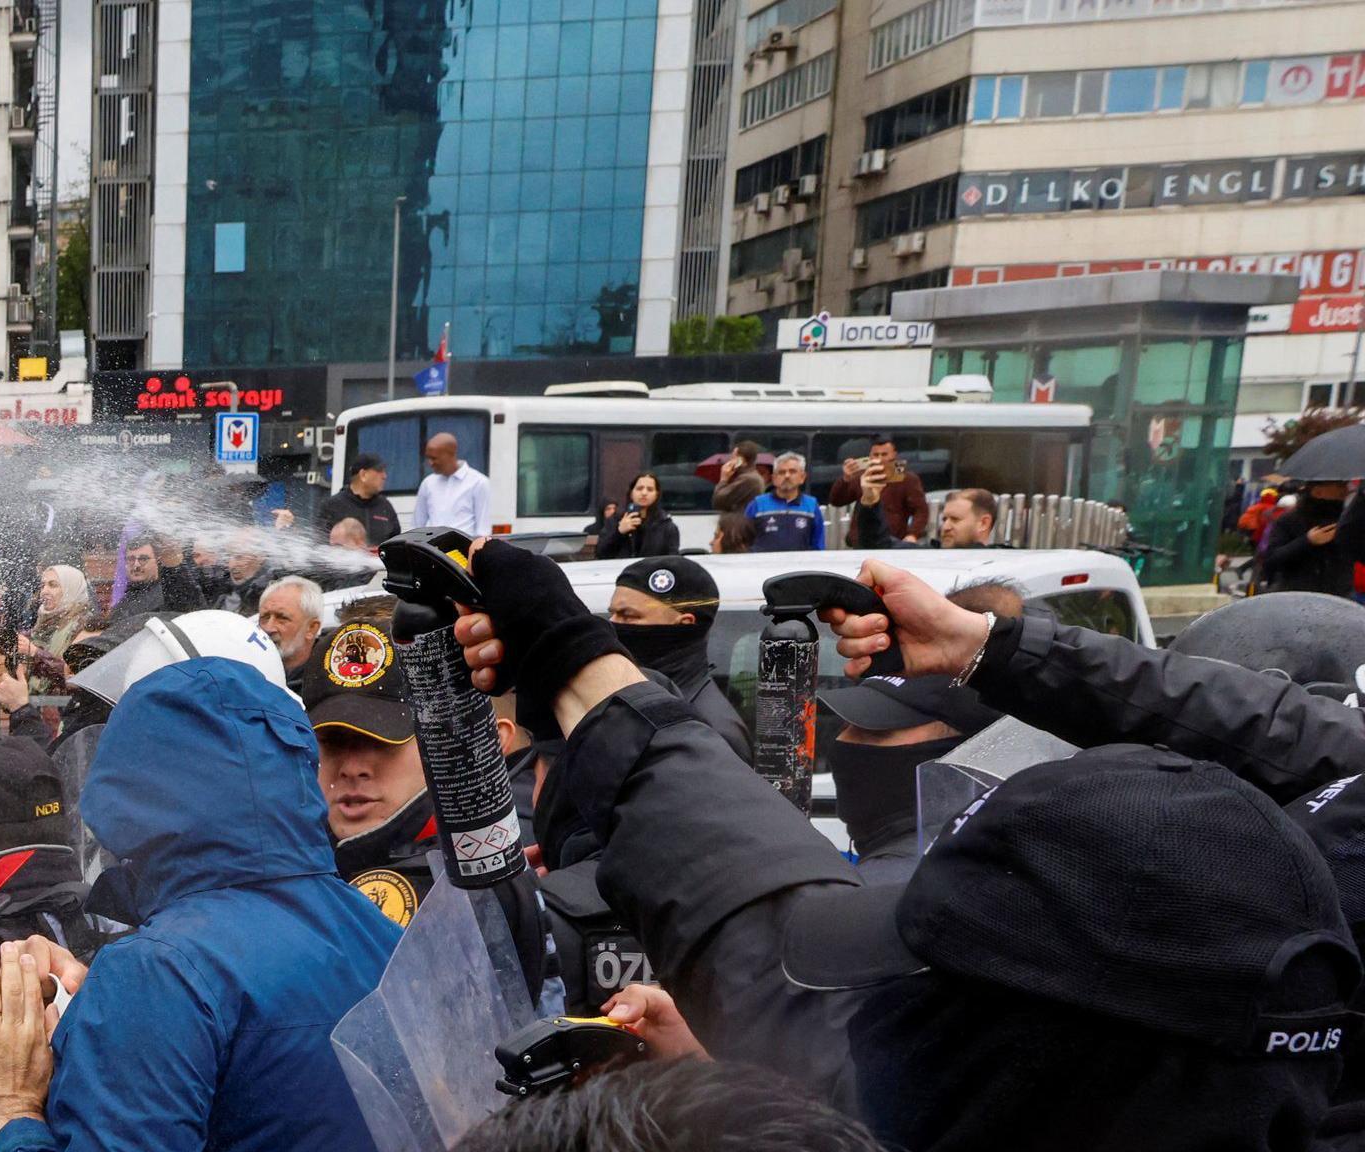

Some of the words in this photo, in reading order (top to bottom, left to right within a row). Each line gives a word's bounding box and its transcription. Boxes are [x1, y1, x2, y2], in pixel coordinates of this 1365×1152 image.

[985, 176, 1124, 206] DİLKO
[1309, 302, 1363, 328] Just
[840, 321, 898, 342] lonca
[137, 377, 197, 409] simit
[205, 388, 284, 411] sarayı
[35, 801, 60, 817] NDB
[1266, 1028, 1342, 1053] POLİS
